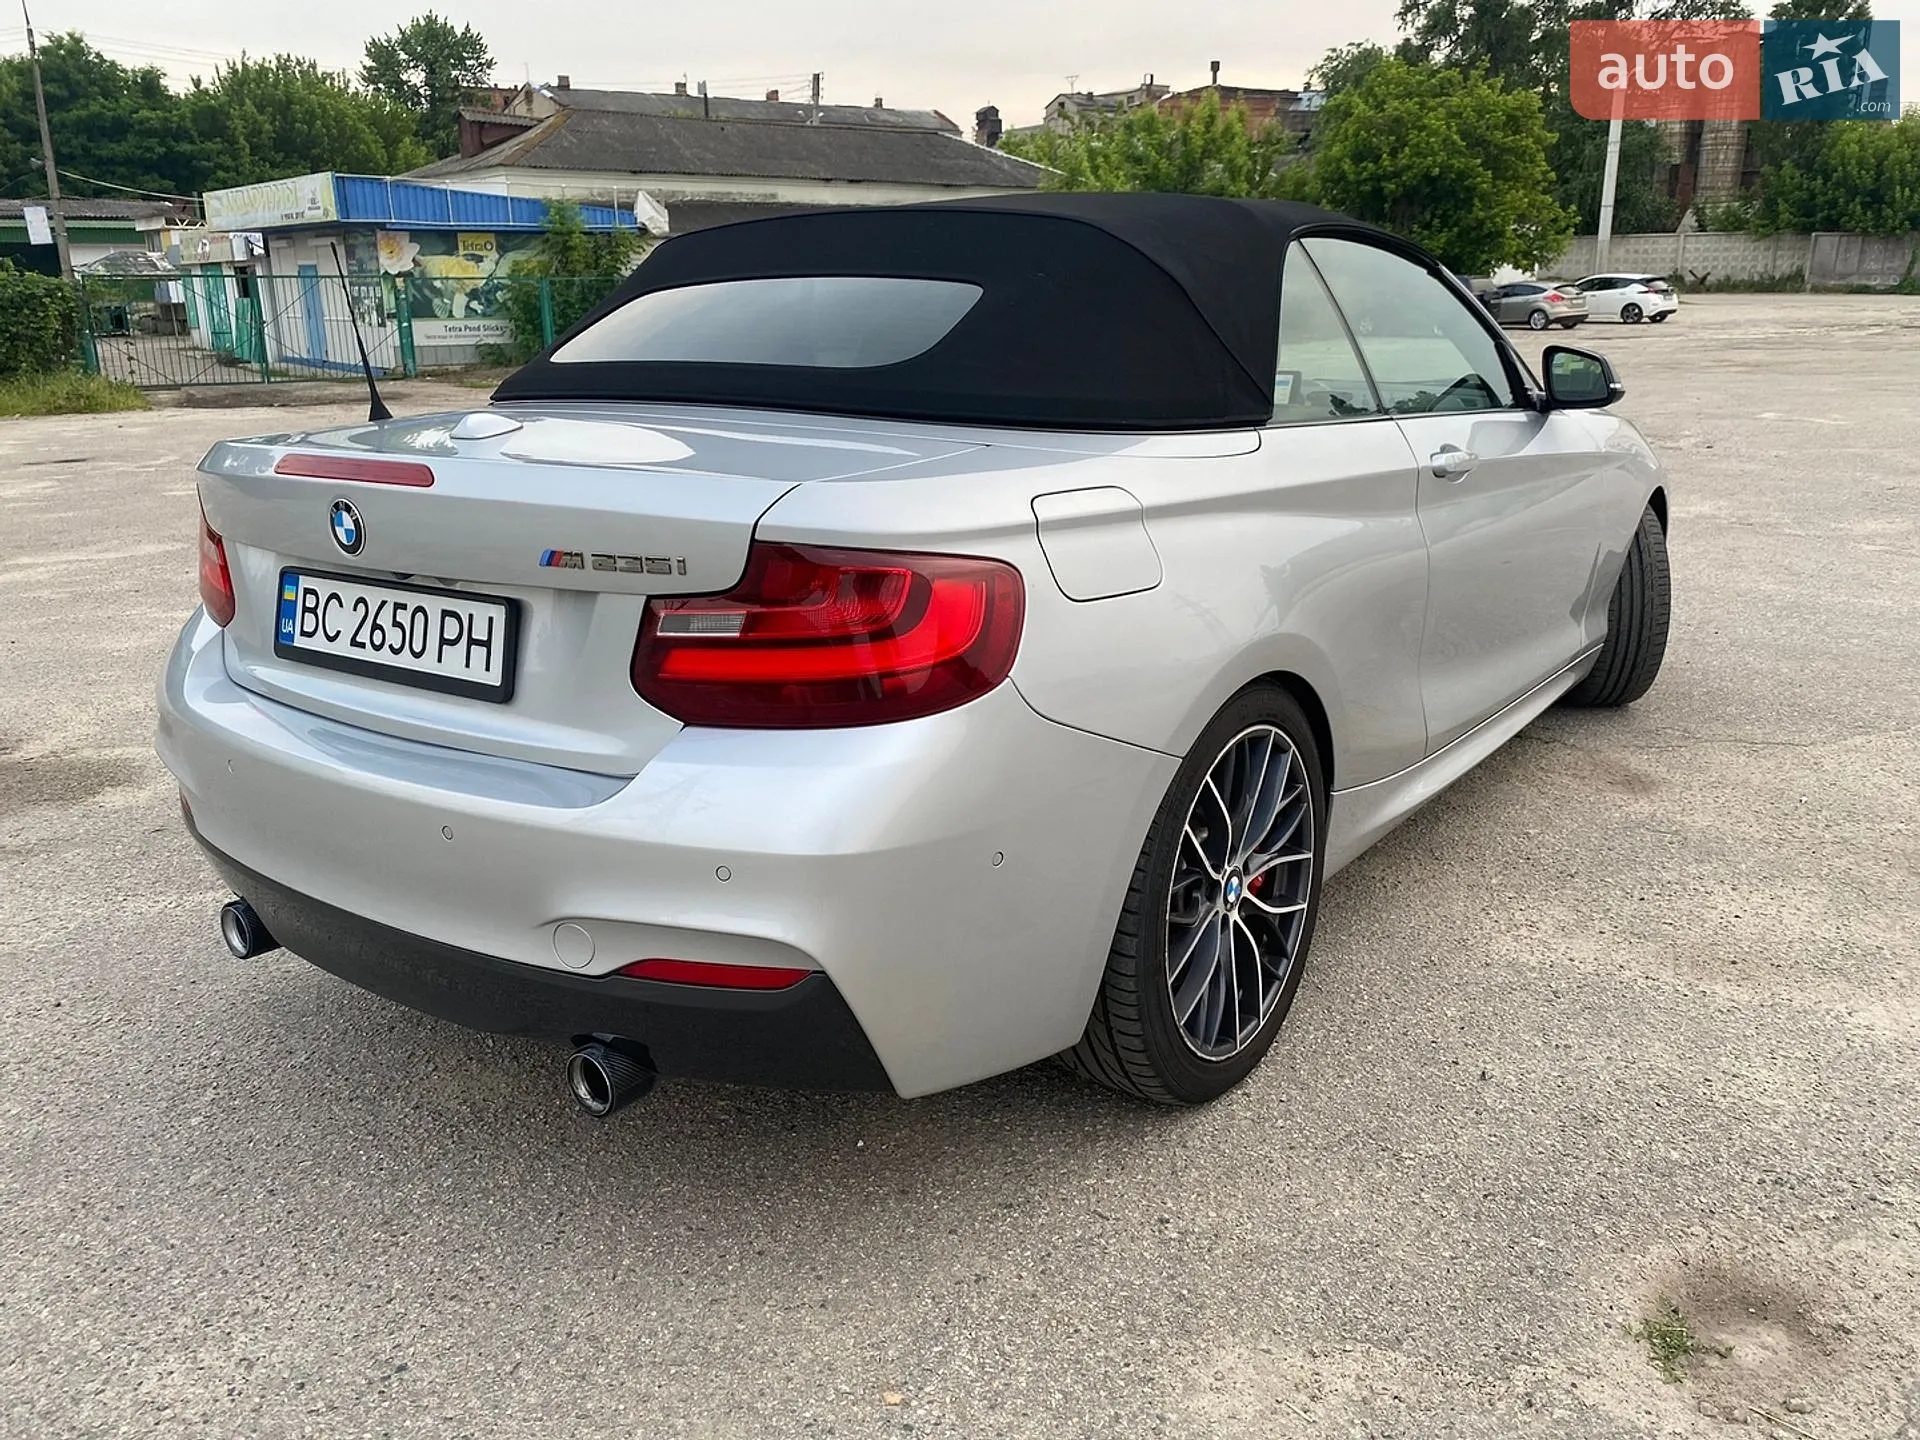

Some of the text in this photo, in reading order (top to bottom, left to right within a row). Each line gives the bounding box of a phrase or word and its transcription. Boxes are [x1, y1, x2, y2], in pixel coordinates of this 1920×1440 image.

[444, 325, 462, 333] Tetra
[464, 324, 481, 332] Pond
[281, 618, 295, 635] UA
[299, 586, 494, 672] BC 2650 PH
